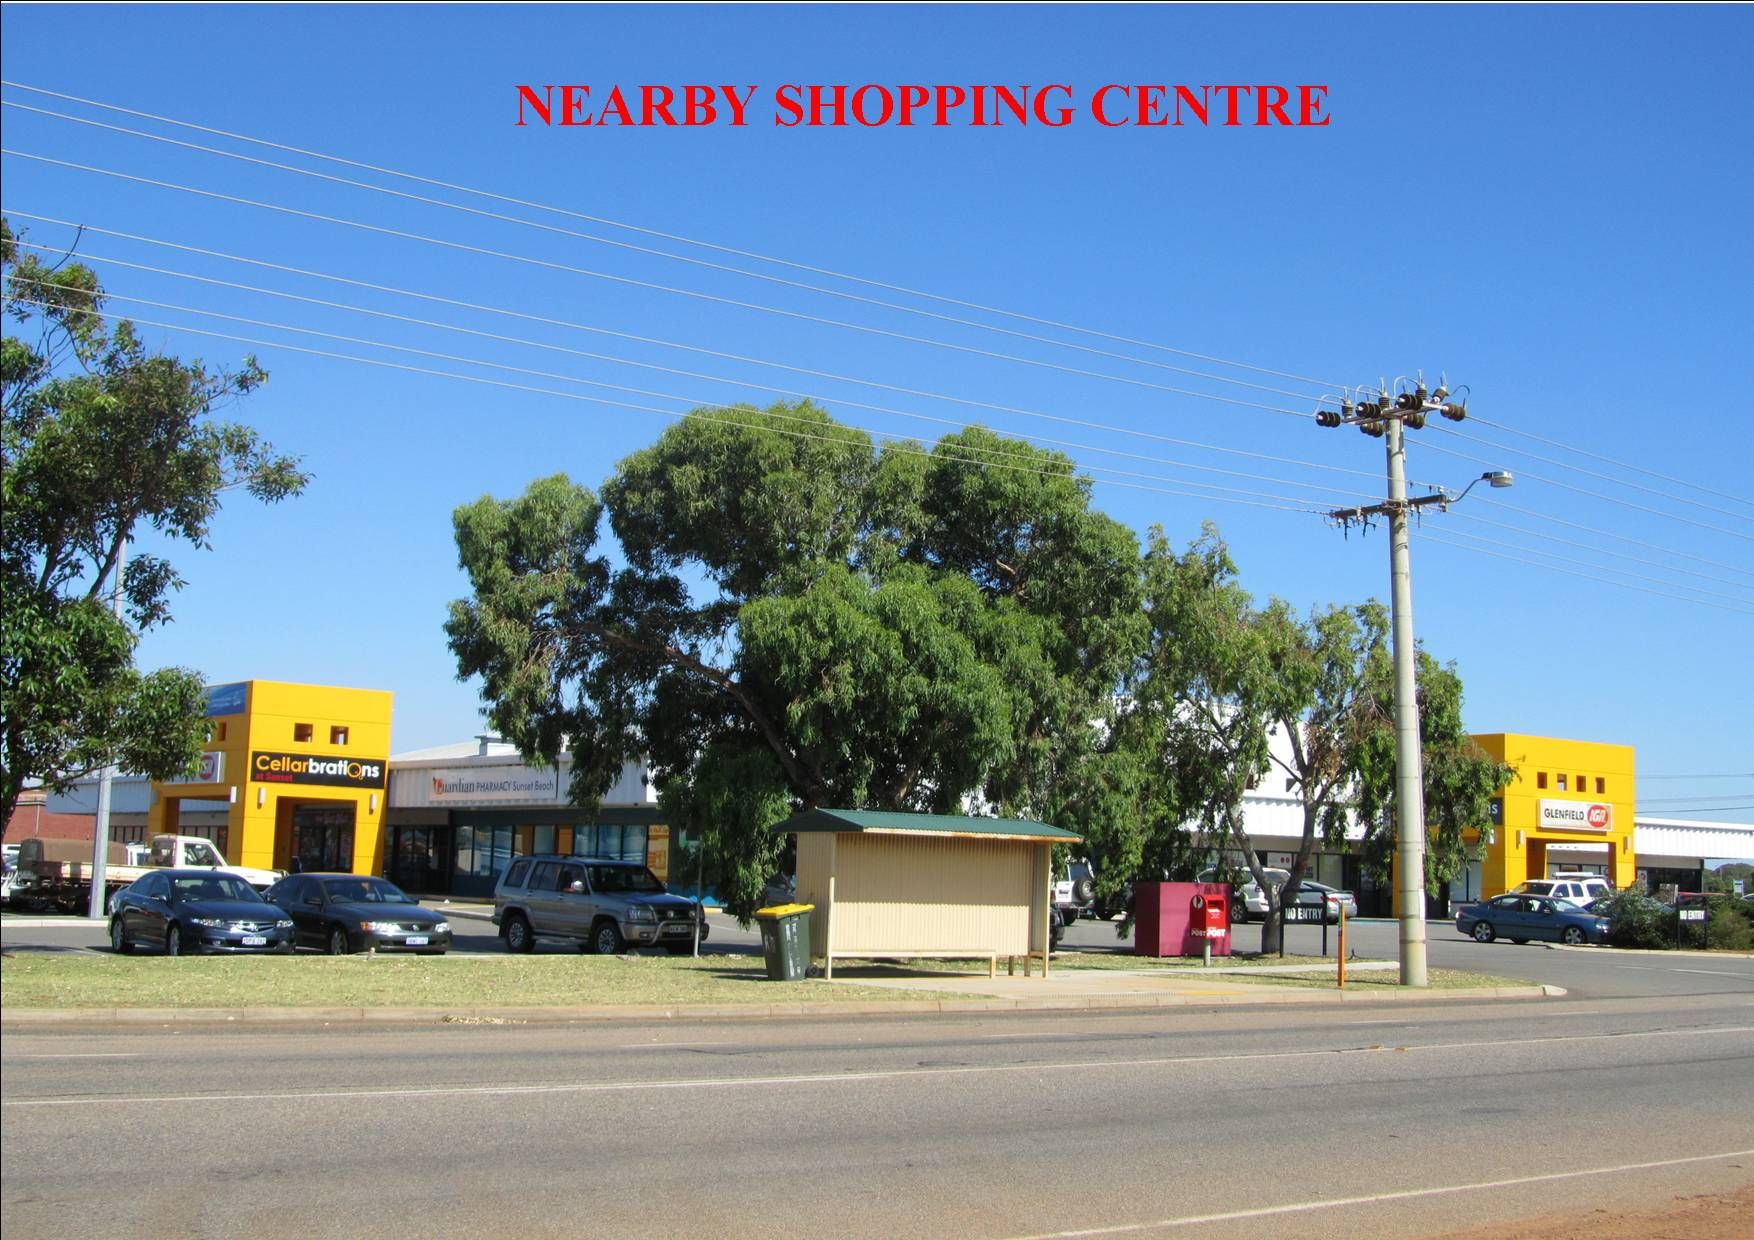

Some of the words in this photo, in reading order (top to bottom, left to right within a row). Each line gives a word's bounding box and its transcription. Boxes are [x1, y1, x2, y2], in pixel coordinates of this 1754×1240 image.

[255, 754, 380, 780] Cellarbrations
[476, 781, 512, 793] PHARMACY
[513, 781, 533, 792] Sunset
[534, 780, 554, 791] Beach
[1544, 808, 1585, 821] GLENFIELD
[1285, 907, 1296, 920] NO
[1297, 907, 1323, 920] ENTRY
